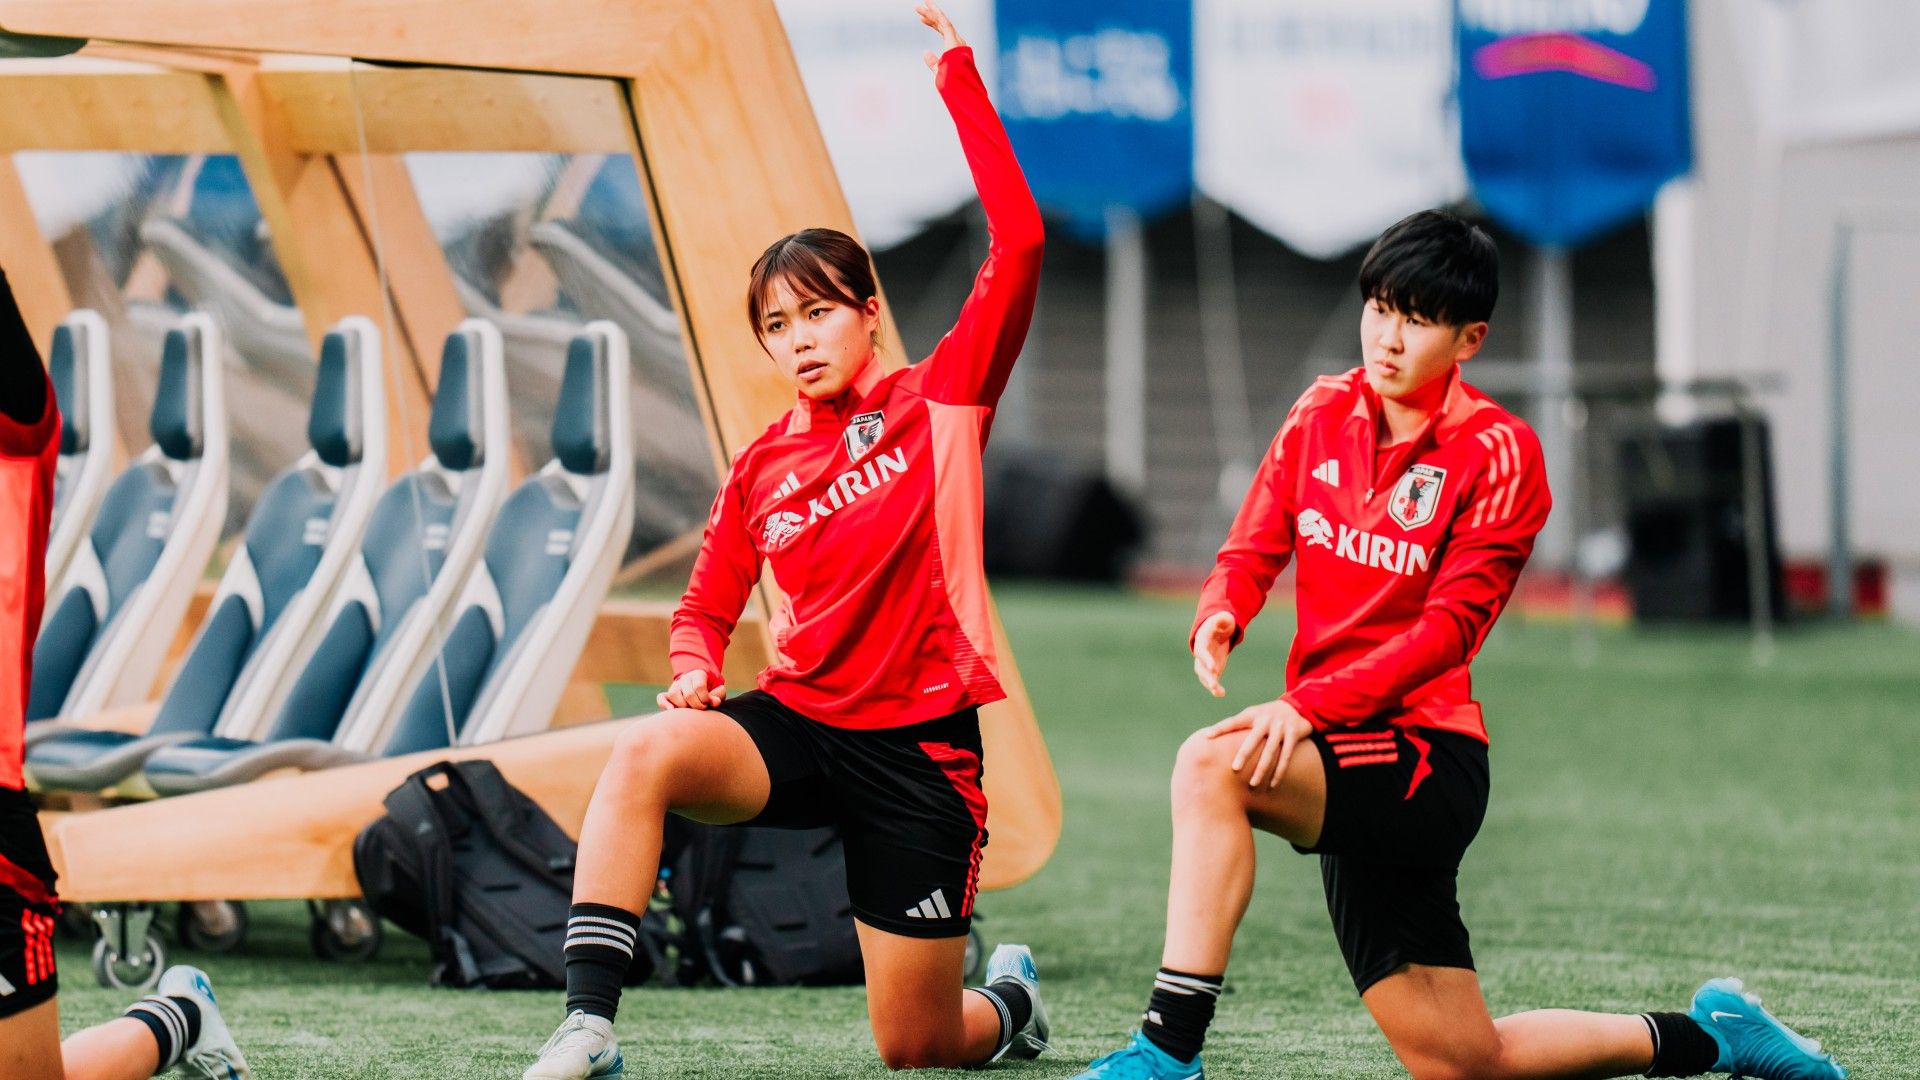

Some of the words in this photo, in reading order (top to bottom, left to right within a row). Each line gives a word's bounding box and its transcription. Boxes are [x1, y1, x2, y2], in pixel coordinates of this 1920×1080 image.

[852, 415, 873, 424] JAPAN
[806, 446, 909, 525] KIRIN
[1335, 523, 1436, 577] KIRIN
